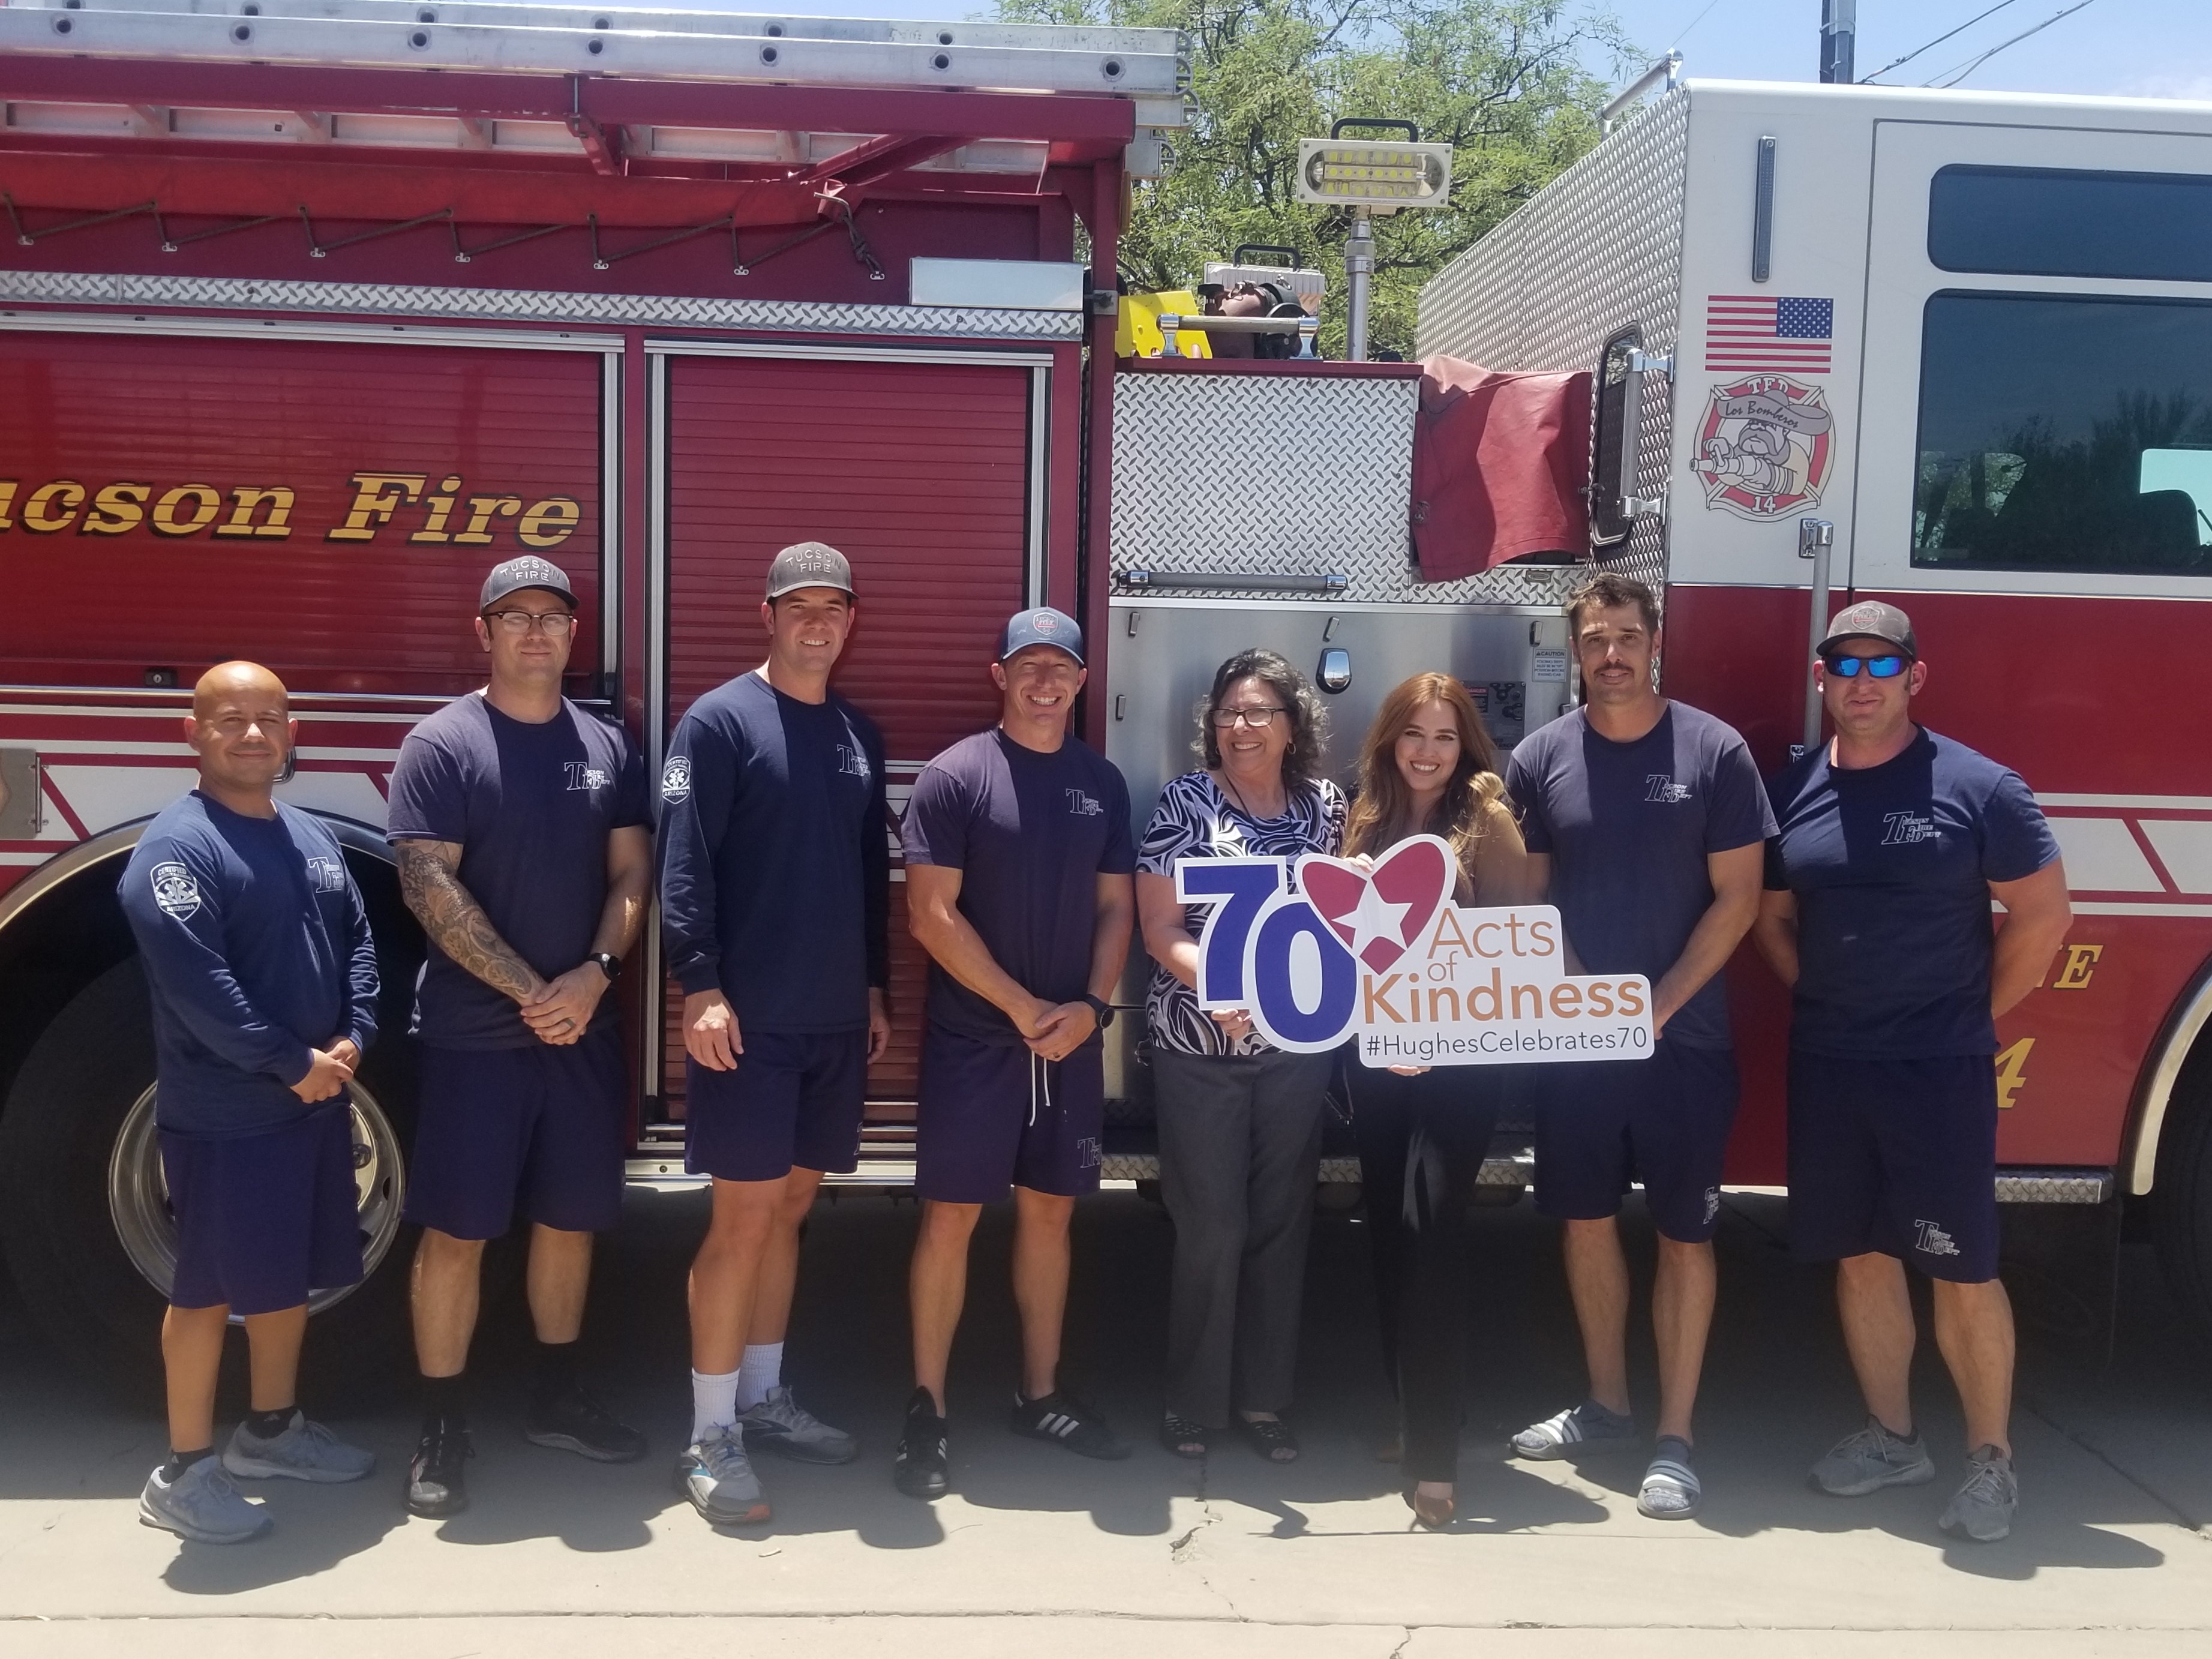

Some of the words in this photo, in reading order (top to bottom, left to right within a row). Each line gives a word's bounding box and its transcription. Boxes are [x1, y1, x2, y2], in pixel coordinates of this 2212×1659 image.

[1746, 377, 1788, 394] TFD
[1725, 401, 1743, 416] Los
[1746, 400, 1800, 428] Bomberos
[0, 479, 296, 540] cson
[325, 471, 581, 548] Fire
[1750, 496, 1776, 514] 14
[500, 559, 560, 581] TUCSON
[785, 549, 842, 570] TUCSON
[800, 562, 831, 574] FIRE
[515, 571, 549, 582] FIRE
[1427, 907, 1555, 961] Acts
[1182, 863, 1357, 1043] 70
[1427, 951, 1458, 982] of
[1362, 967, 1645, 1025] Kindness
[1366, 1026, 1647, 1061] #HughesCelebrates70
